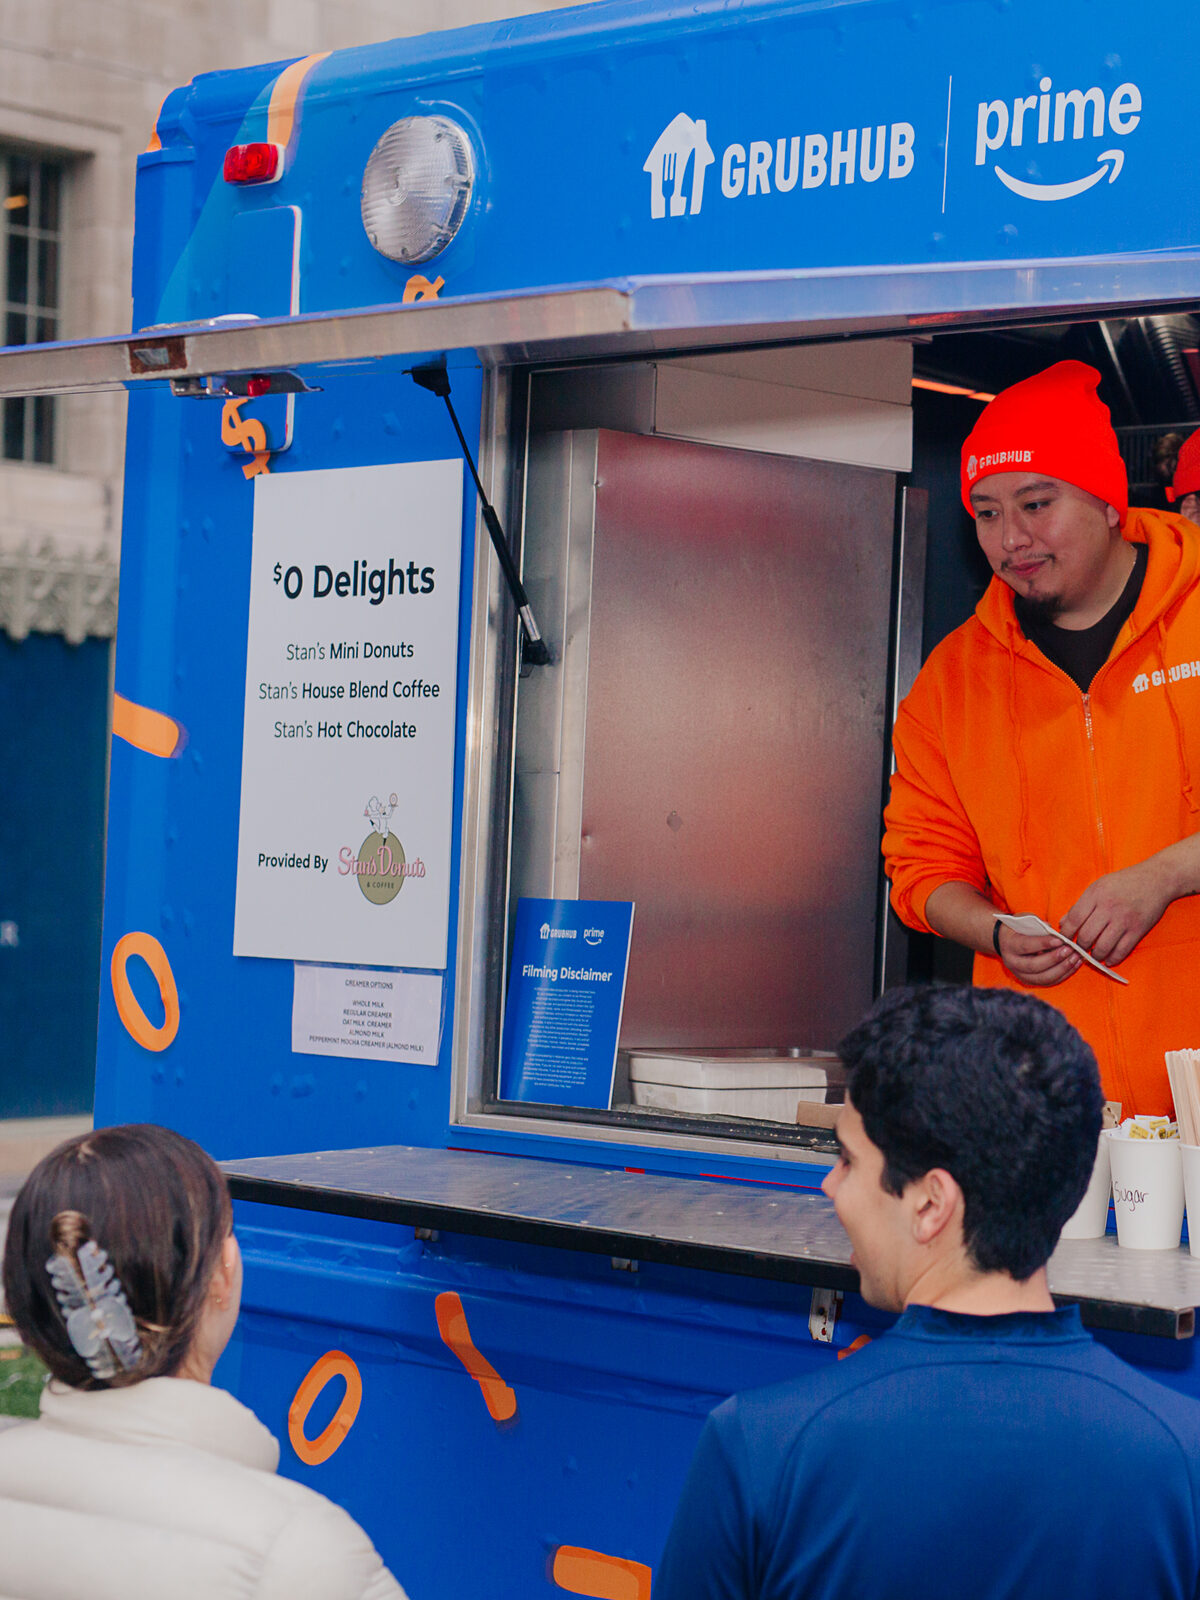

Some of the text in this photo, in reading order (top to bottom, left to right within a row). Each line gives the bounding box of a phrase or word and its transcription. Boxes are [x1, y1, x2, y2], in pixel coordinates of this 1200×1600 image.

[975, 76, 1143, 167] prime
[720, 122, 915, 200] GRUBHUB
[980, 450, 1032, 469] GRUBHUB
[313, 558, 435, 606] Delights
[286, 641, 414, 661] Stan's Mini Donuts
[259, 679, 440, 700] Stan's House Blend Coffee
[273, 719, 417, 739] Stan's Hot Chocolate
[258, 853, 329, 873] Provided By
[376, 845, 426, 879] Donuts
[372, 881, 395, 890] COFFEE
[583, 926, 605, 939] prime
[522, 965, 613, 983] Filming Disclaimer
[345, 978, 394, 990] CREAMER OPTIONS
[343, 1008, 393, 1019] REGULAR CREAMER
[352, 1000, 385, 1009] WHOLE MILK
[353, 1019, 365, 1027] MILK
[366, 1019, 393, 1029] CREAMER
[349, 1029, 385, 1039] ALMOND MILK
[360, 1039, 386, 1049] CREAMER
[1114, 1180, 1150, 1212] Sugar
